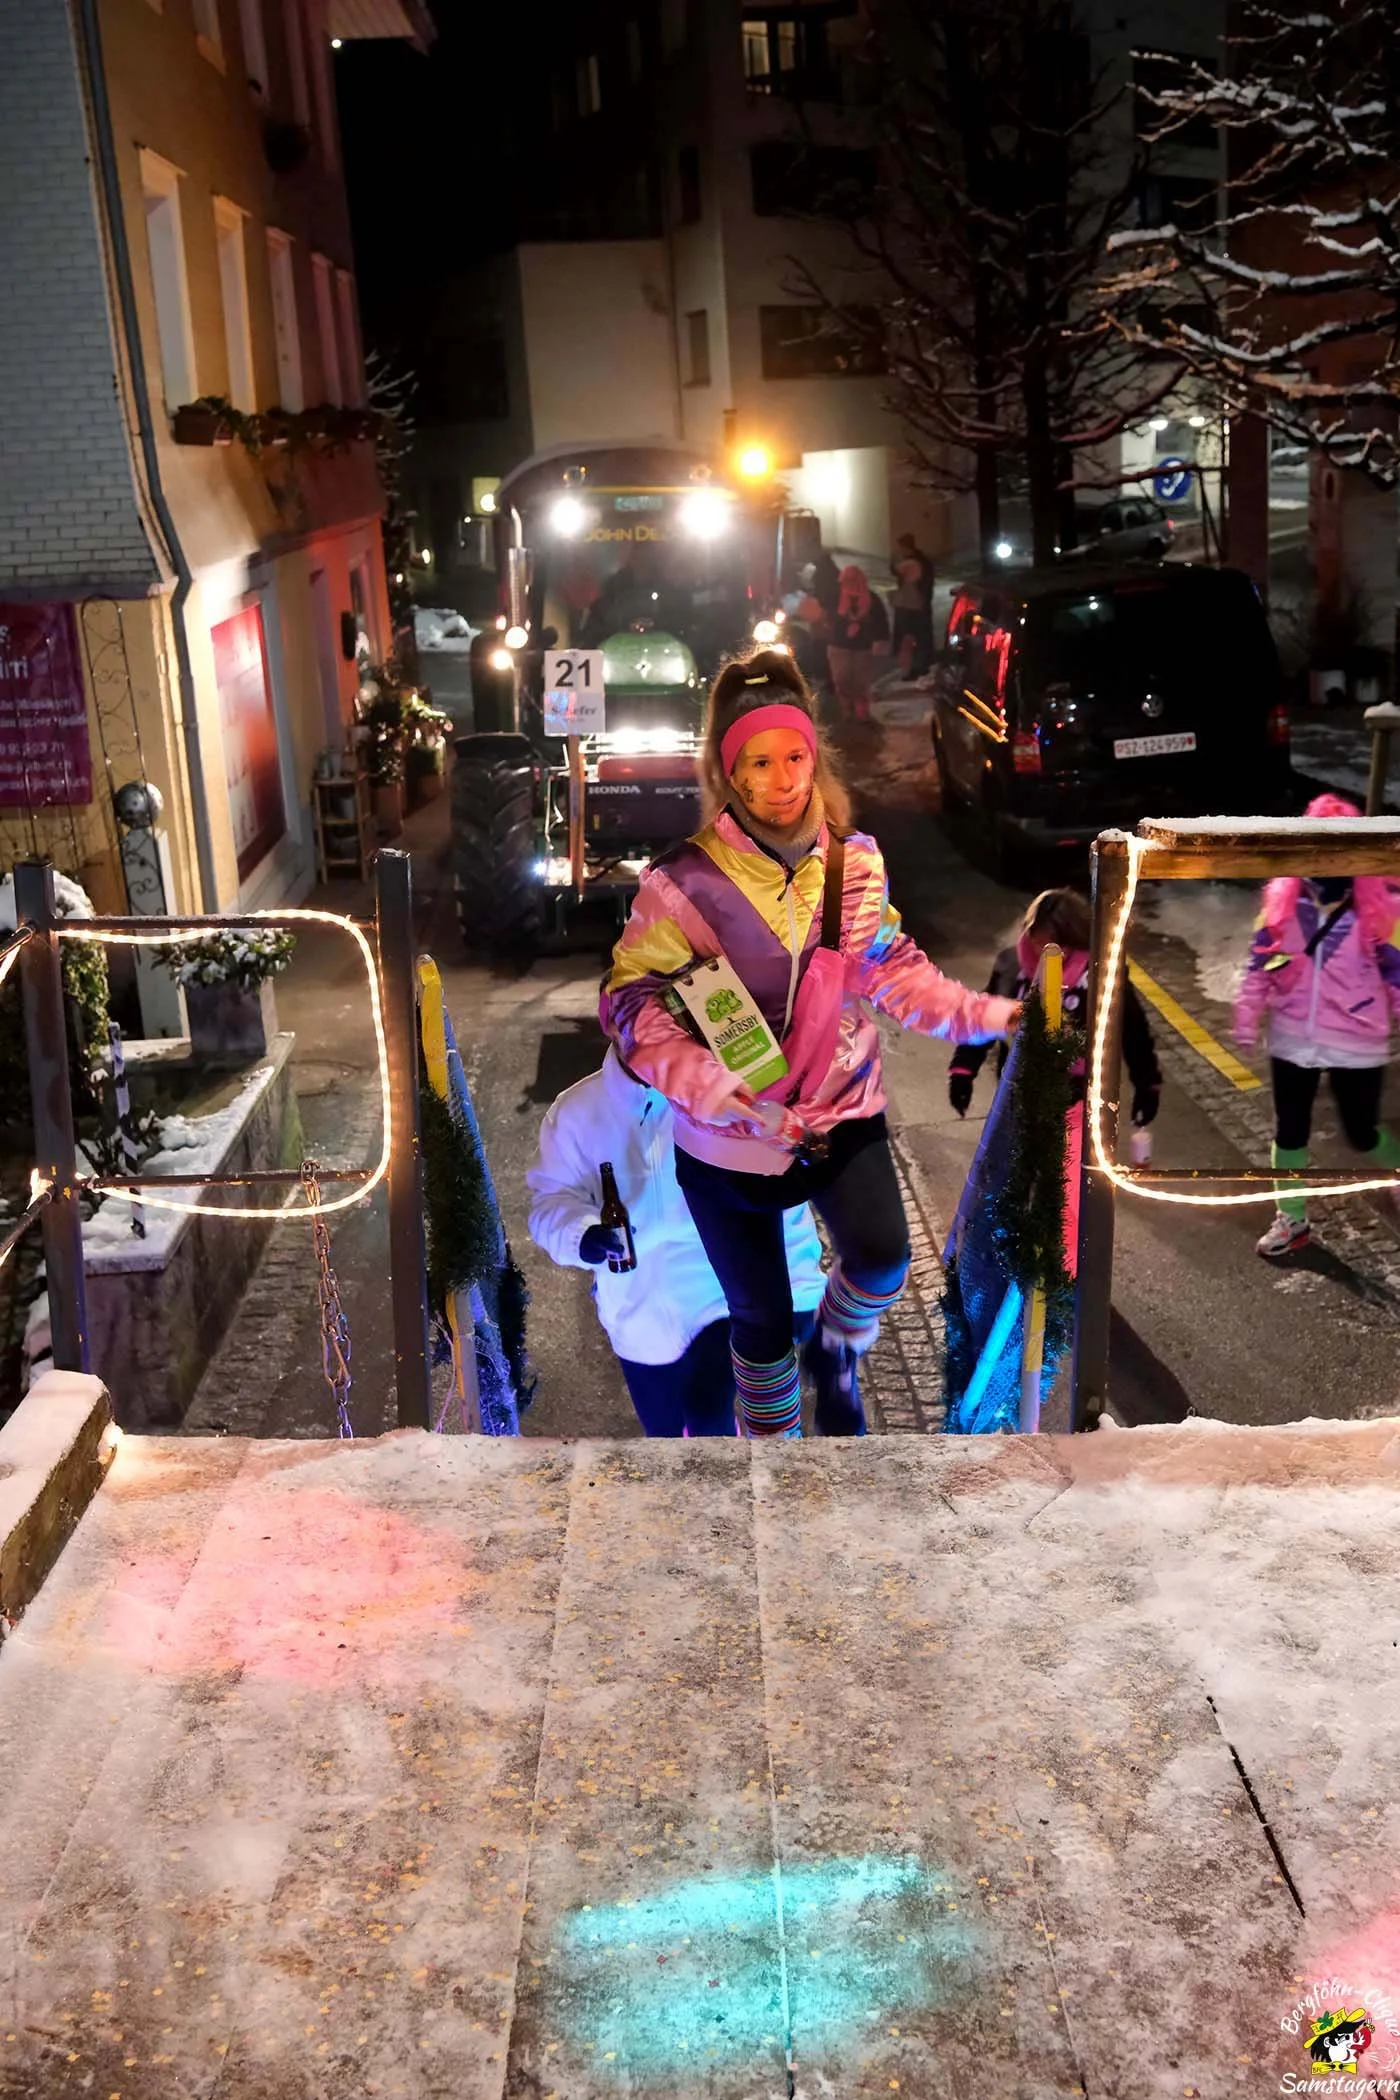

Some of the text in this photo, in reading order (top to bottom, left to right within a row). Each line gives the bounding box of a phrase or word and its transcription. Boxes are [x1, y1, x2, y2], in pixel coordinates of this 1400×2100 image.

[555, 658, 590, 687] 21
[588, 785, 641, 795] HONDA
[714, 1015, 759, 1048] SOMERSBY
